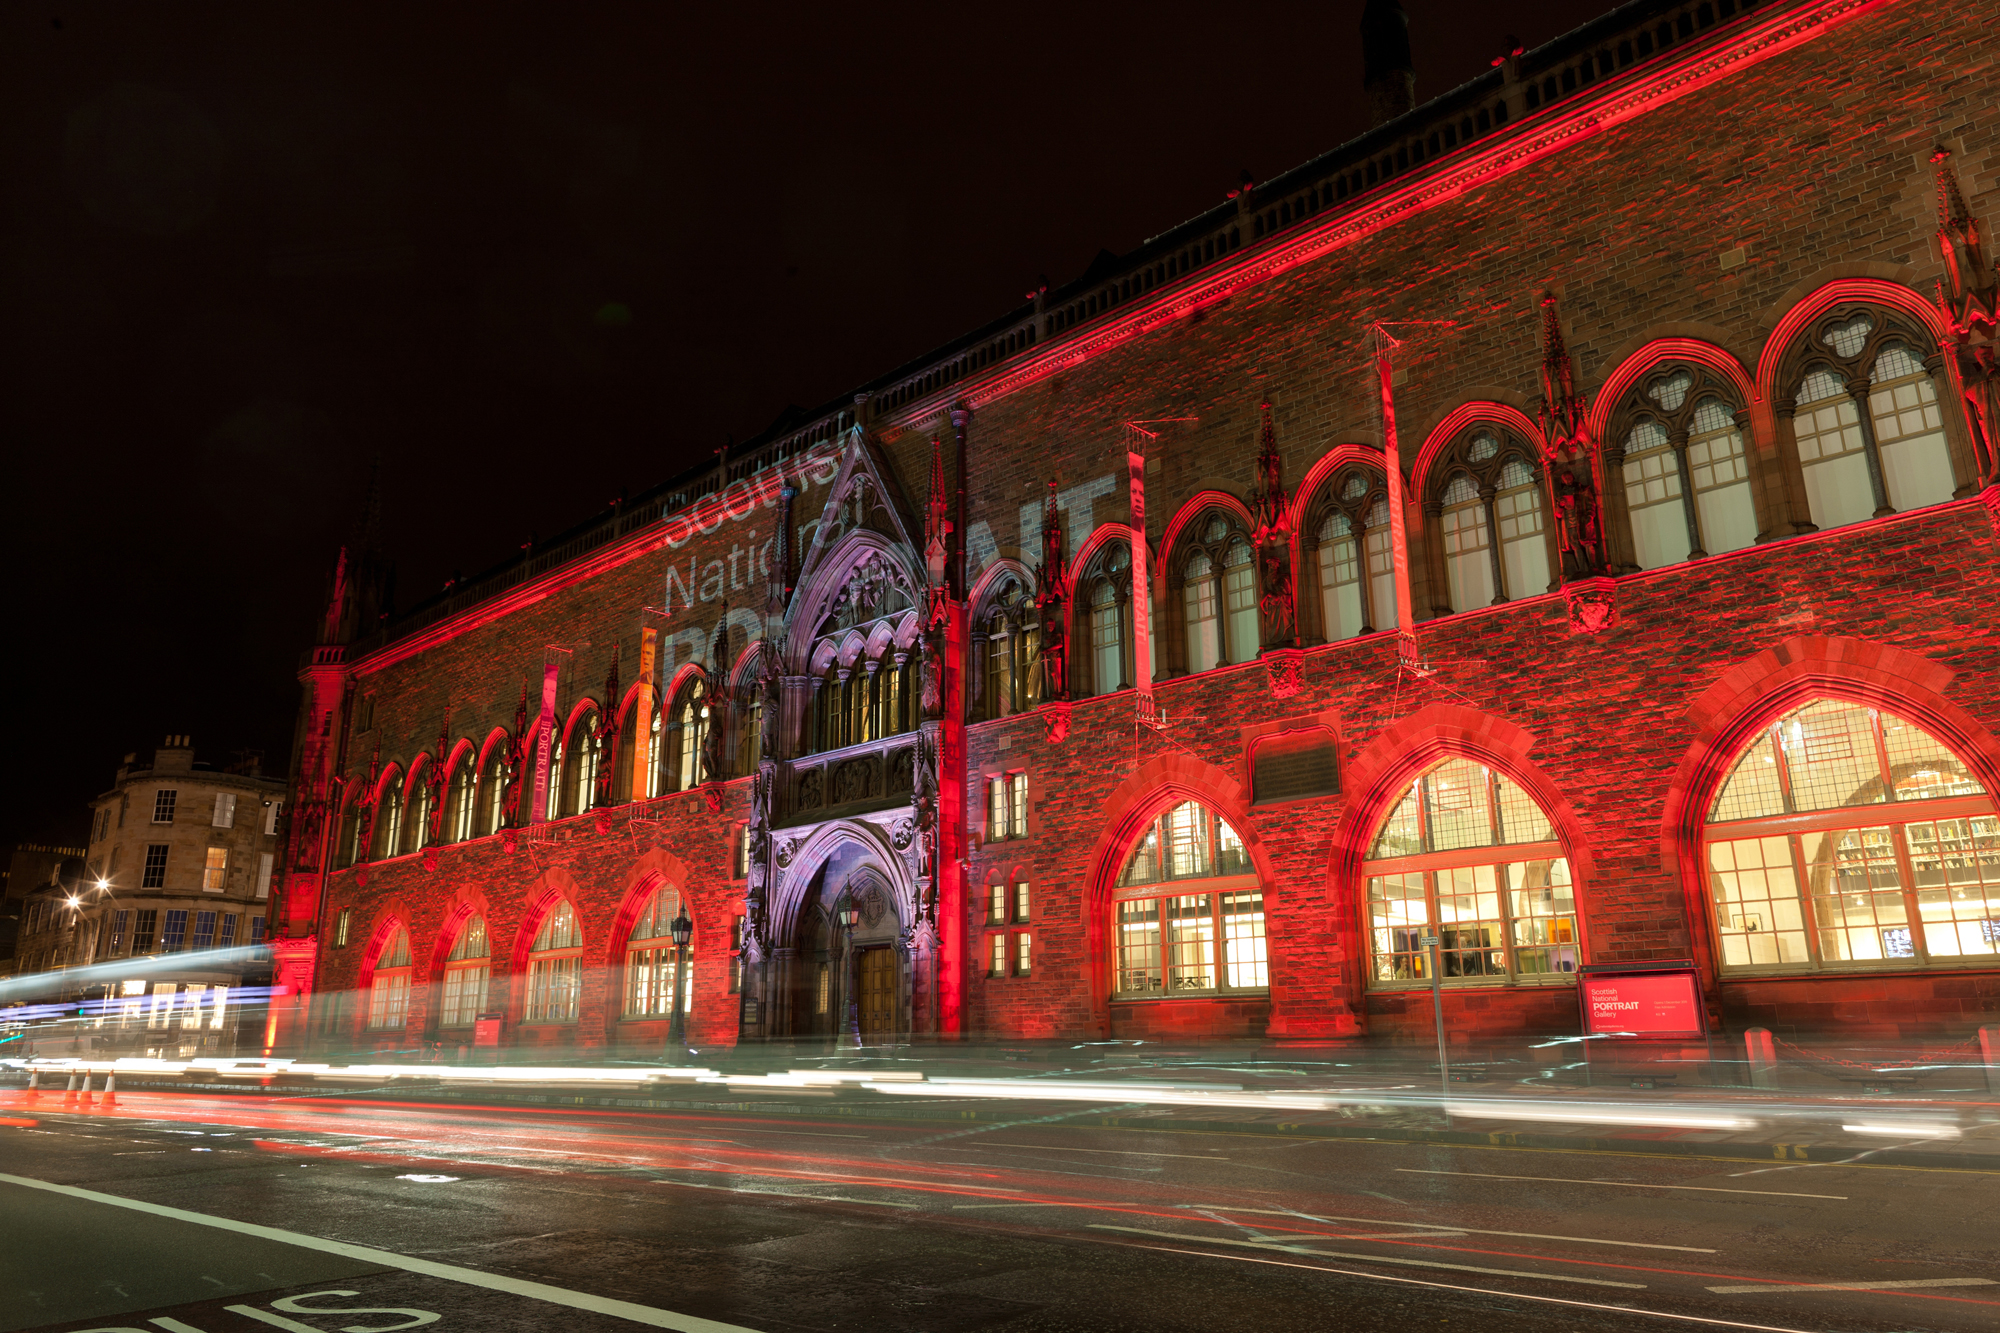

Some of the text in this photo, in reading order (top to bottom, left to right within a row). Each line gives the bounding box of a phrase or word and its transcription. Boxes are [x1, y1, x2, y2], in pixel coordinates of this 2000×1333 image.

[1133, 545, 1148, 642] PORTRAIT
[535, 726, 550, 790] PORTRAIT
[636, 694, 650, 763] PORTRAIT
[1593, 1001, 1639, 1011] PORTRAIT
[1594, 1011, 1617, 1019] Gallery
